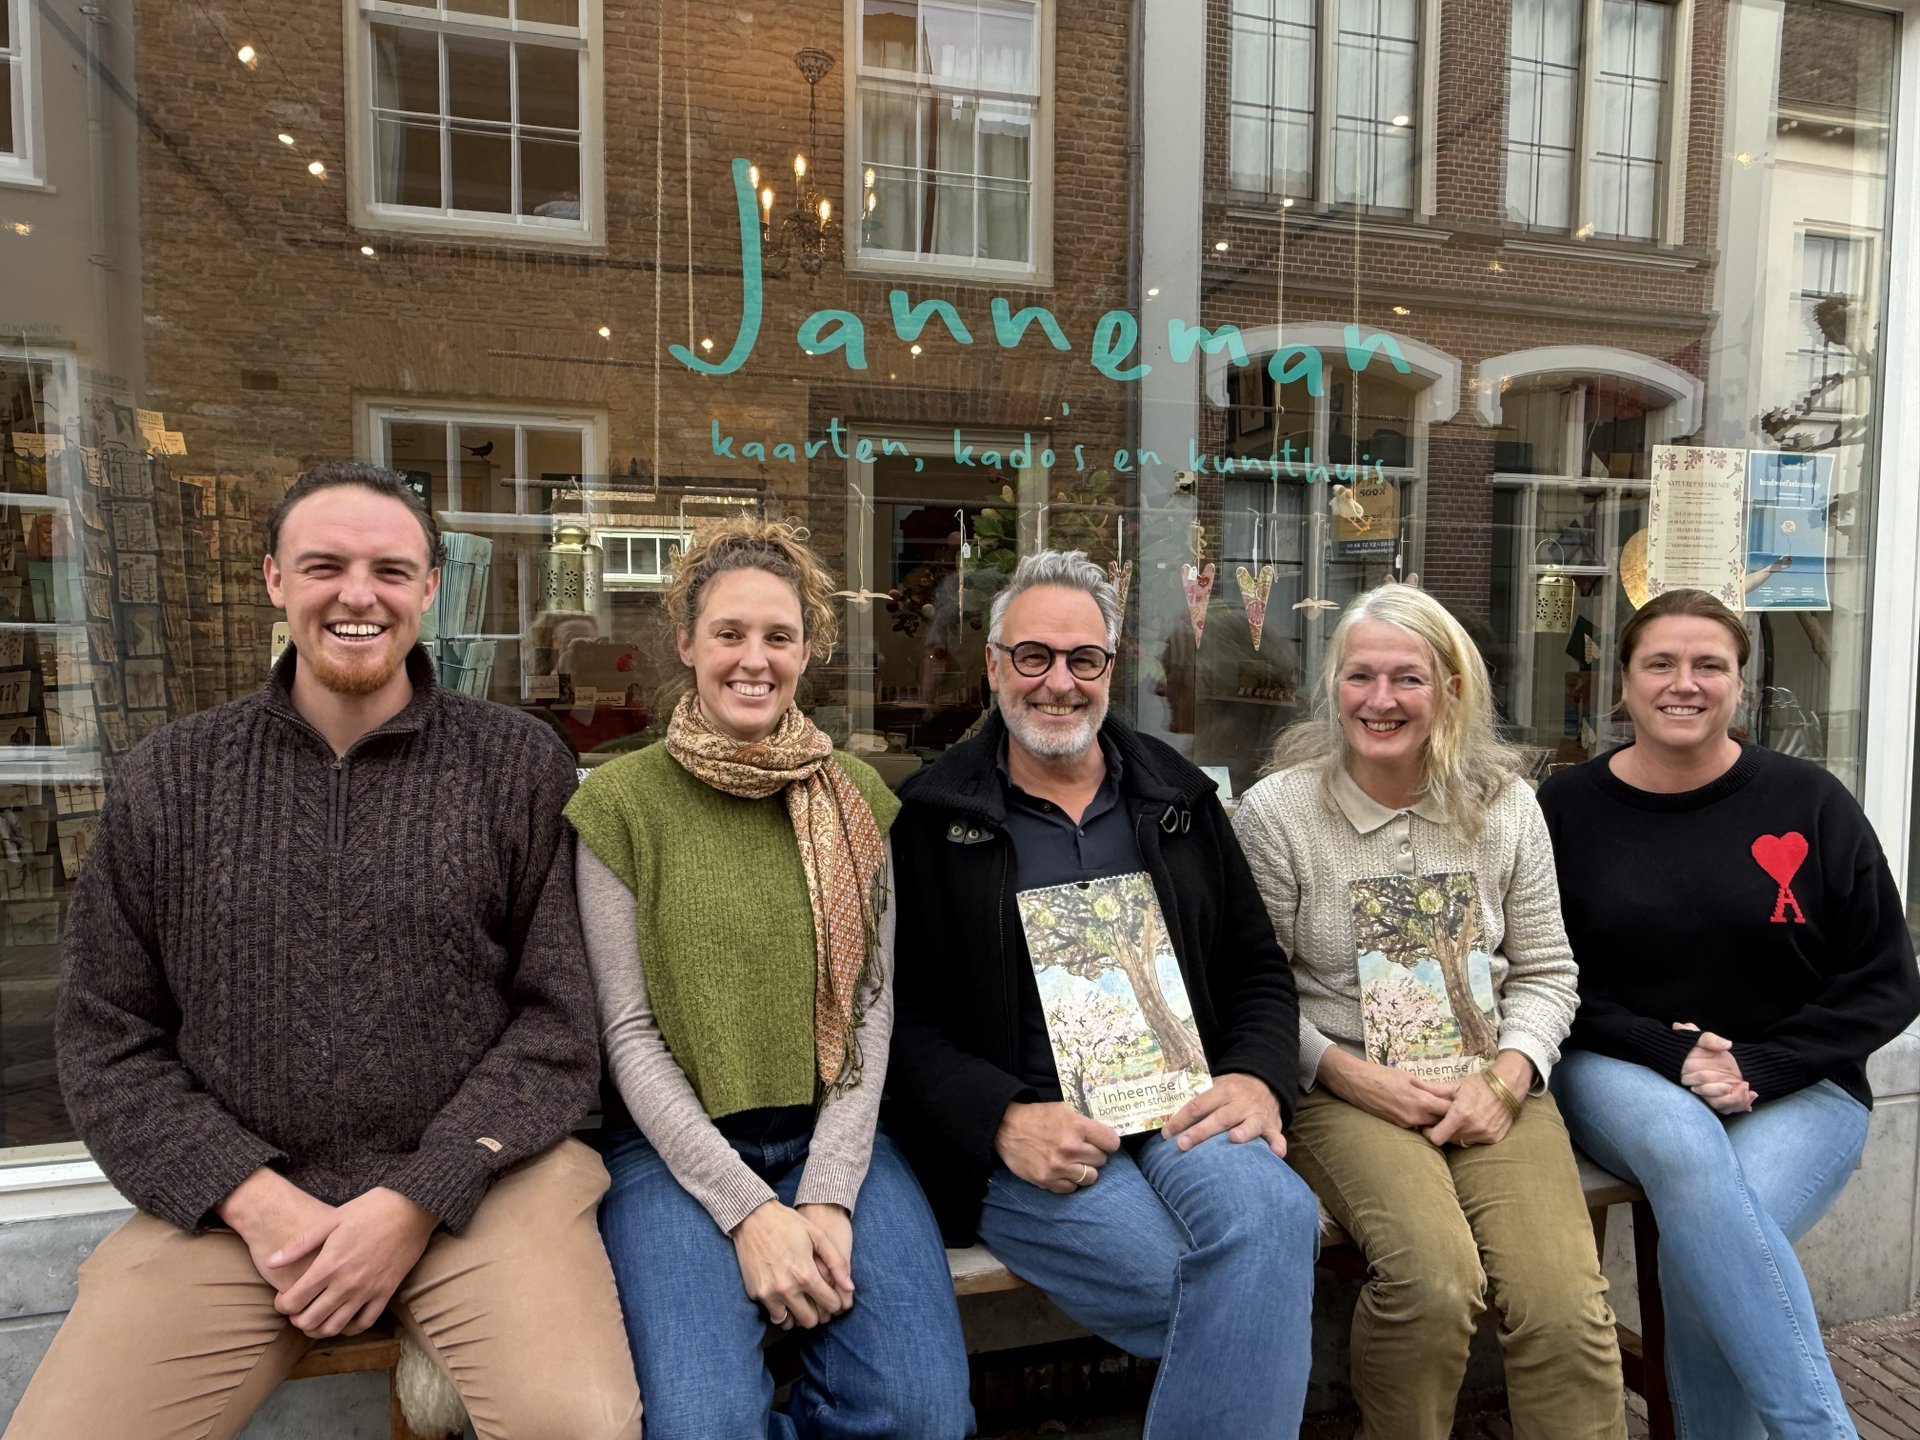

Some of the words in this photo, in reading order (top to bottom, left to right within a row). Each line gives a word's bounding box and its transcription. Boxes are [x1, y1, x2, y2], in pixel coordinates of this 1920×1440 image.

[669, 157, 1412, 397] Janneman
[711, 417, 924, 472] kaarten,
[1113, 449, 1162, 473] en
[1188, 438, 1384, 485] kunsthuis
[1098, 1102, 1132, 1116] bomen
[1133, 1101, 1146, 1109] en
[1148, 1091, 1186, 1106] struiken
[1103, 1081, 1176, 1105] Inheemse
